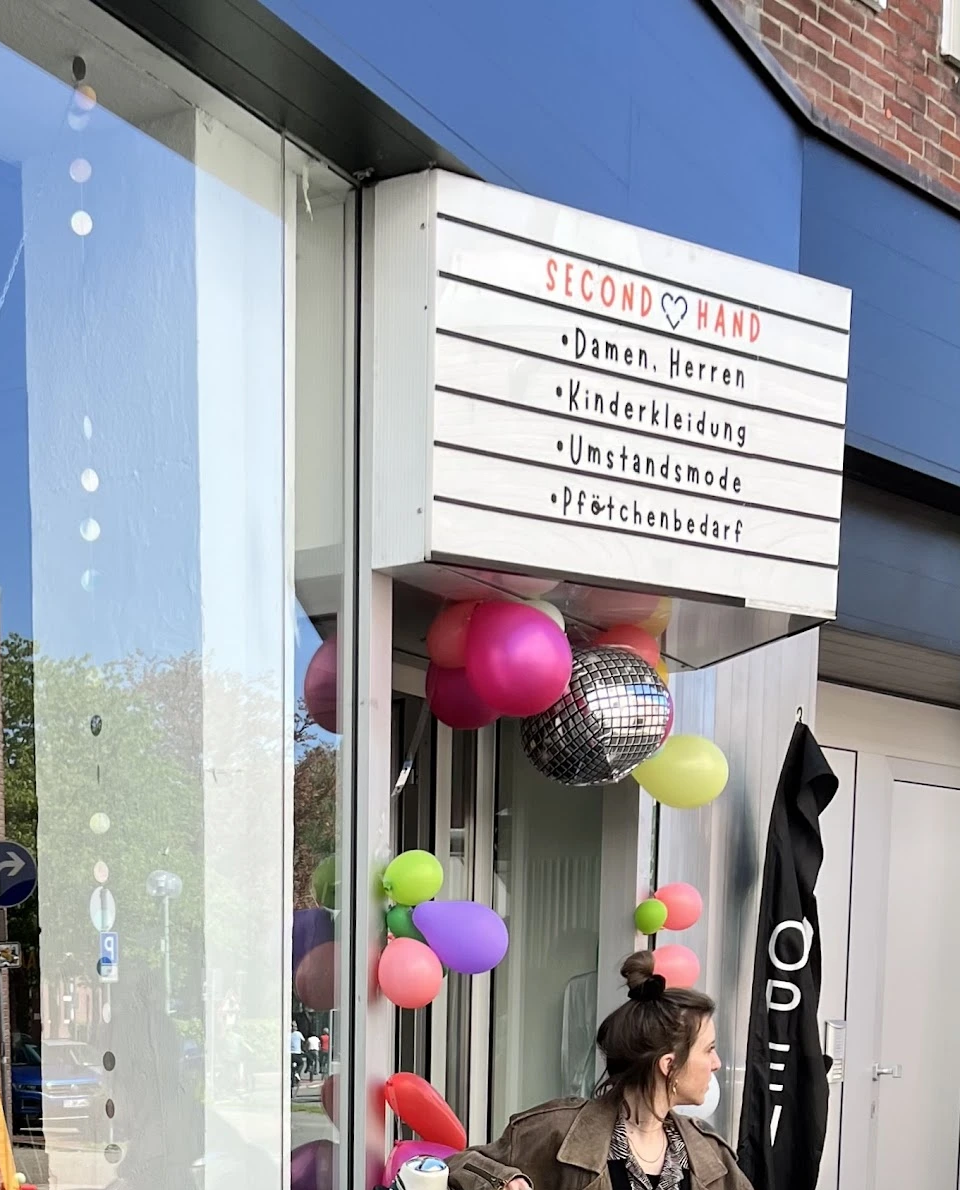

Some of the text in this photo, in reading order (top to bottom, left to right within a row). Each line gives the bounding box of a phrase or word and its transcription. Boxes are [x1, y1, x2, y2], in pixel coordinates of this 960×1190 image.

[545, 258, 762, 343] SECOND HAND
[669, 347, 746, 389] Herren
[568, 378, 747, 448] Kinderkleidung
[569, 434, 742, 494] Umstandsmode
